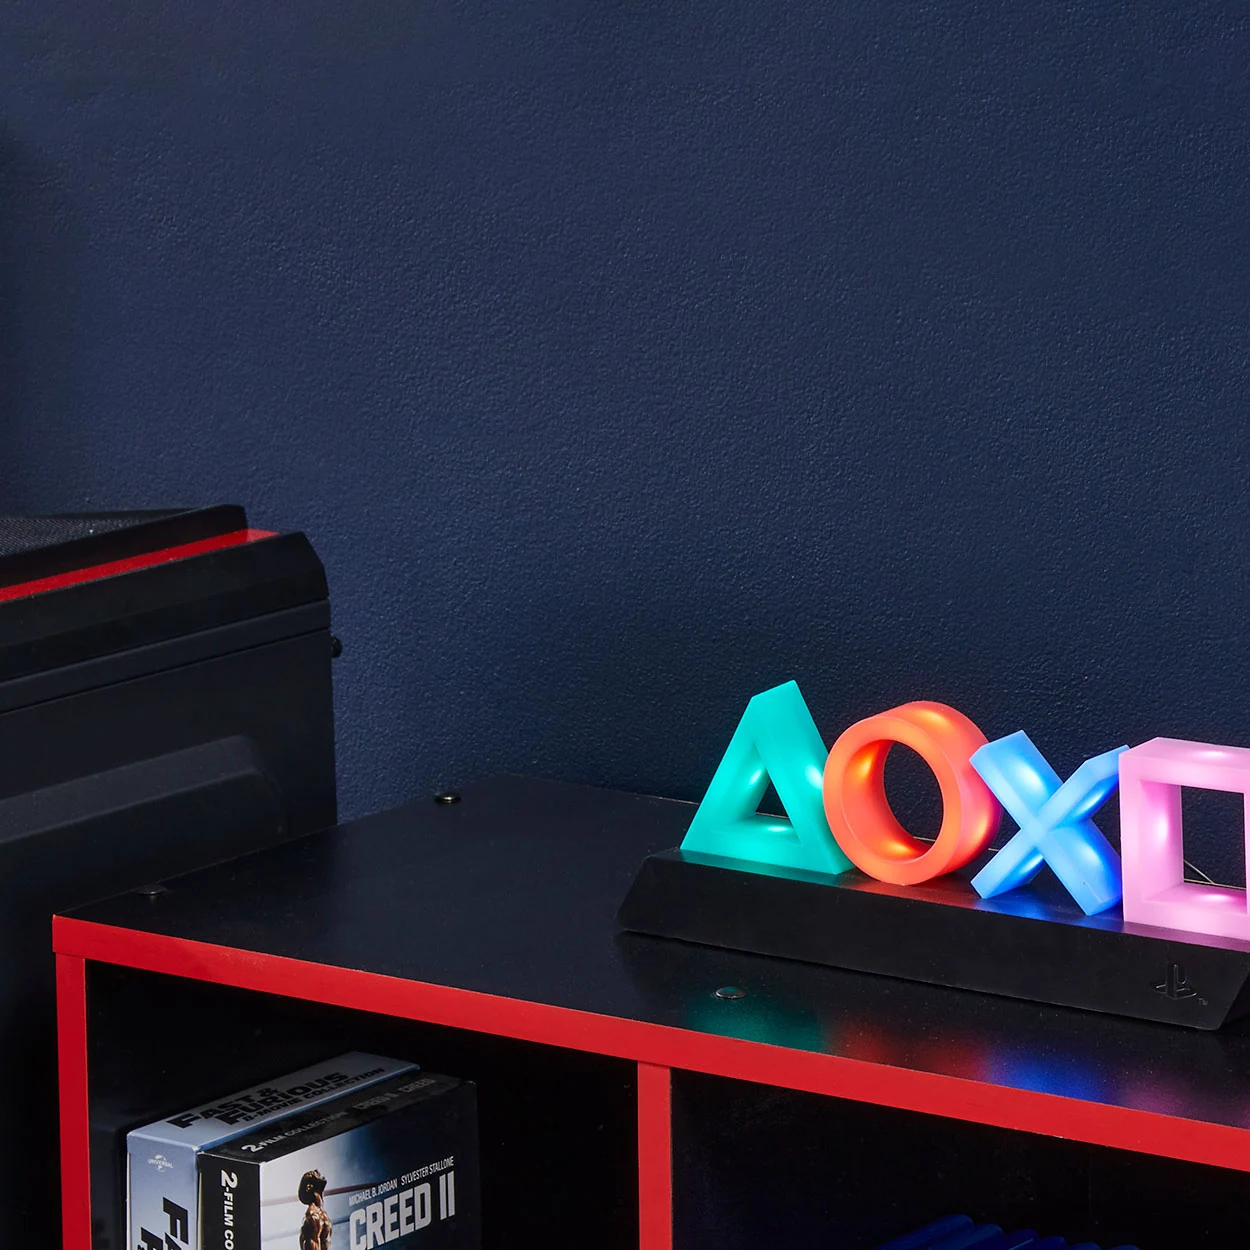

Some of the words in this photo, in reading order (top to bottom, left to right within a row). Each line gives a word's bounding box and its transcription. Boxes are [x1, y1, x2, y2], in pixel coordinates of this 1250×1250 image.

[166, 1093, 257, 1128] FAST
[215, 1071, 348, 1125] FURIOUS
[220, 1169, 239, 1227] 2-FILM
[348, 1190, 372, 1206] MICHAEL
[378, 1178, 398, 1195] JORDAN
[401, 1166, 429, 1186] SYLVESTER
[429, 1156, 454, 1175] STALLONE
[439, 1170, 455, 1220] II
